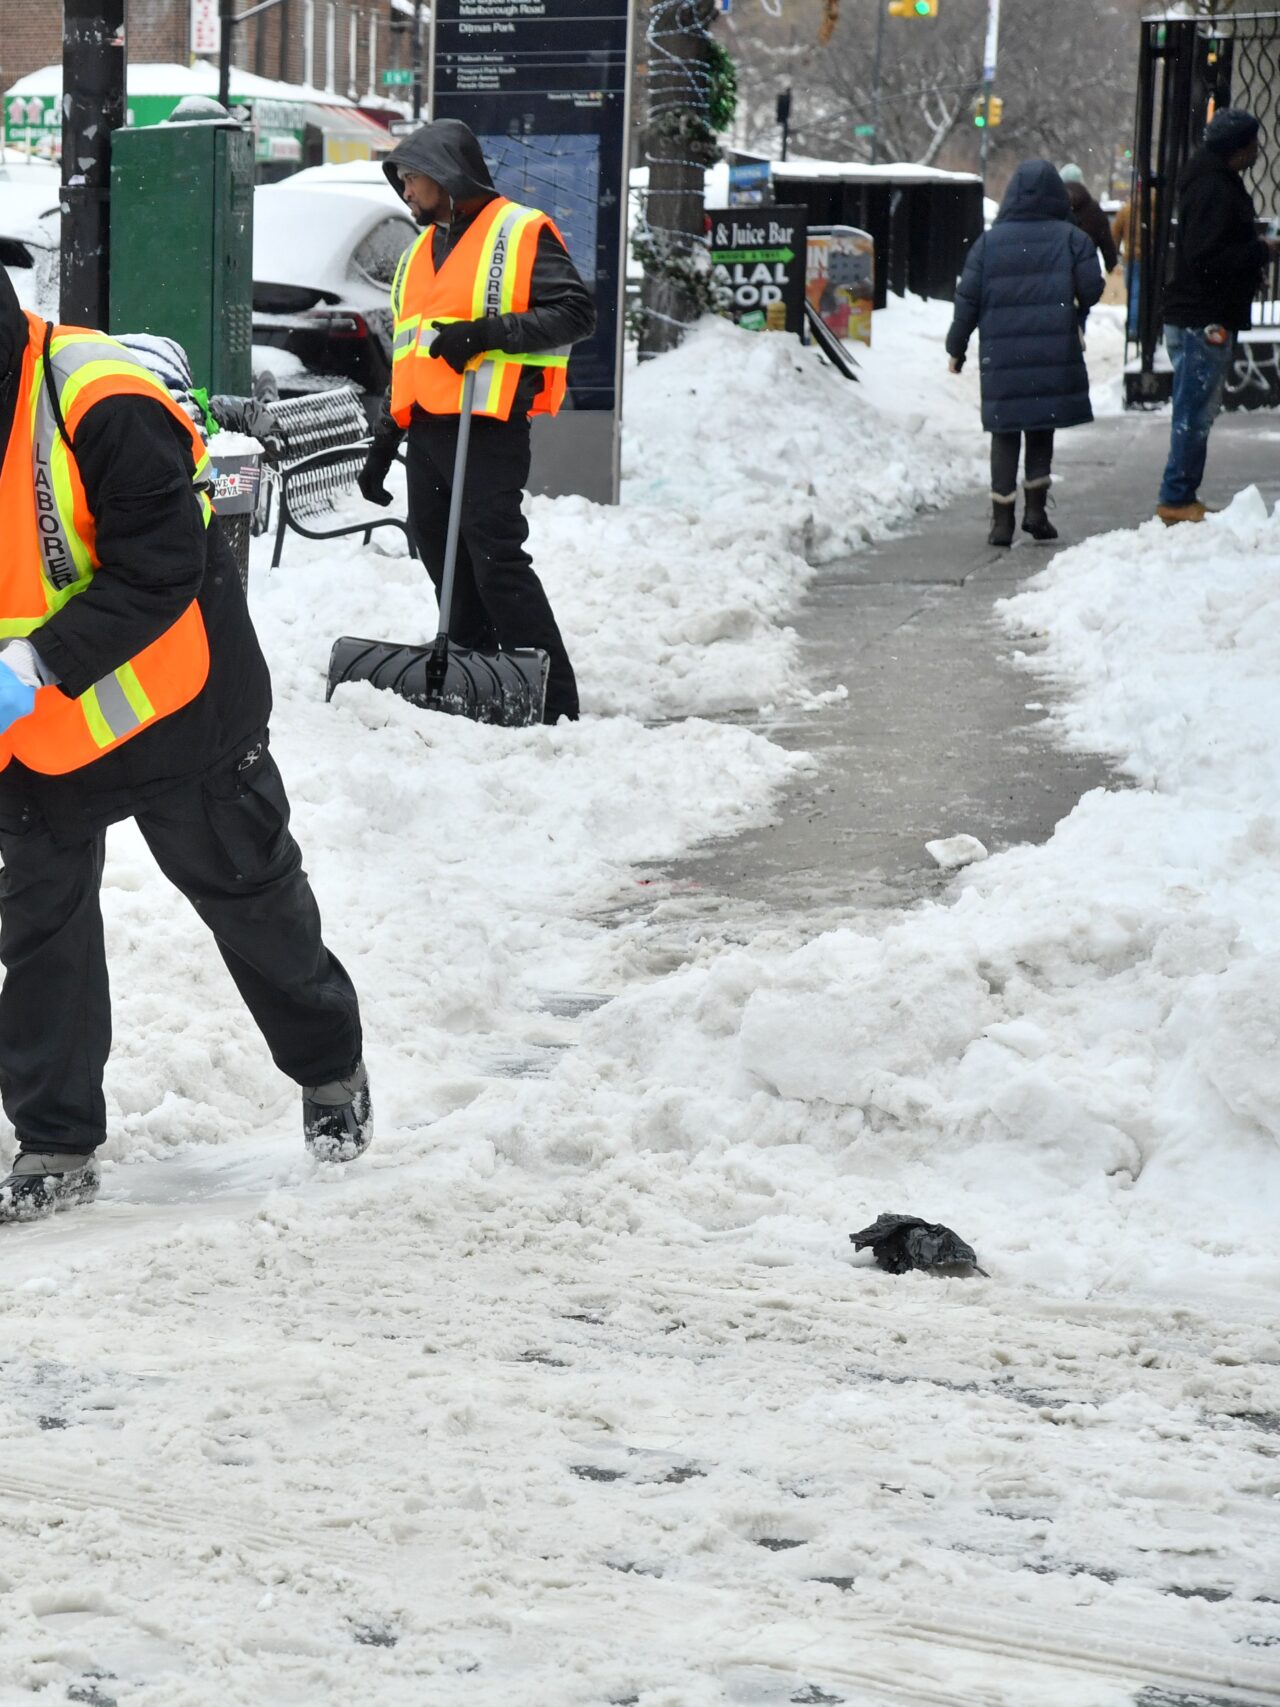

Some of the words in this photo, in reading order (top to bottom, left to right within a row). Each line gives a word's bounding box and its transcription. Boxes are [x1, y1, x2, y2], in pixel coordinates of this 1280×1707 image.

[459, 4, 518, 16] Marlborough
[520, 4, 546, 14] Road
[459, 23, 492, 33] Ditmas
[493, 22, 515, 32] Park
[716, 222, 729, 246] &
[731, 222, 766, 249] Juice
[768, 221, 794, 244] Bar
[486, 227, 507, 318] LABORER
[713, 262, 789, 285] ALAL
[713, 285, 782, 307] OOD
[35, 442, 73, 592] LABORER
